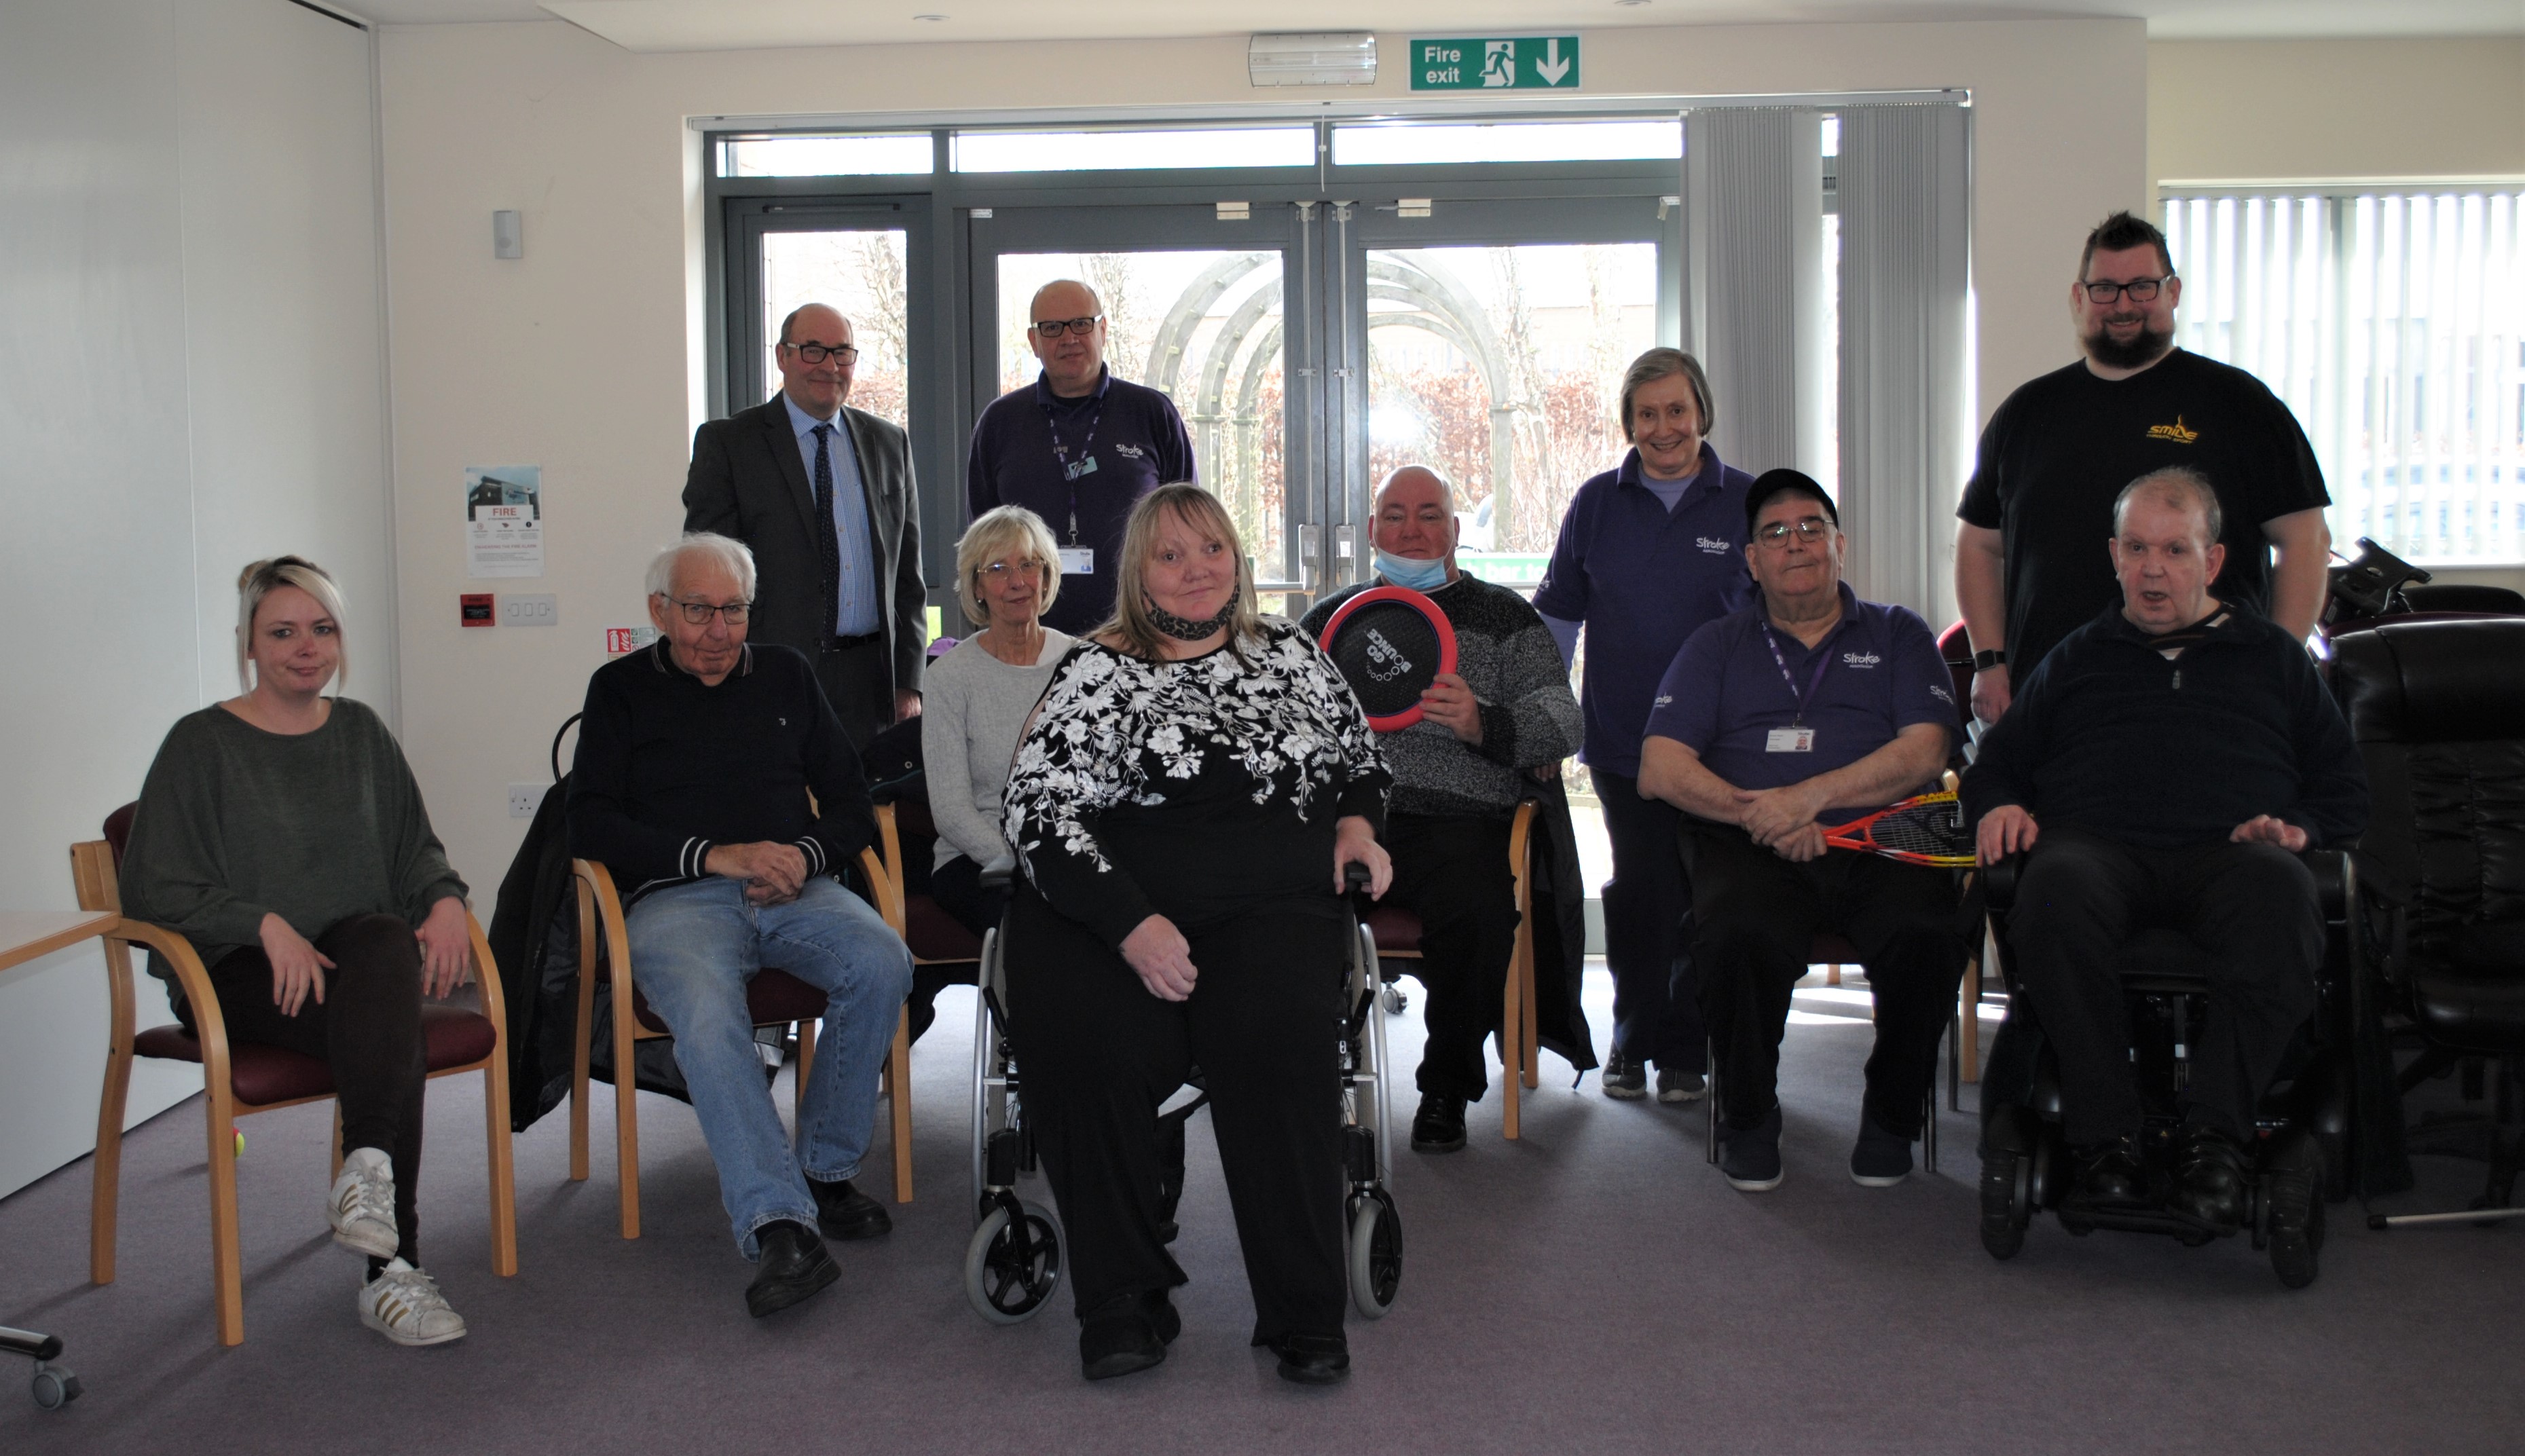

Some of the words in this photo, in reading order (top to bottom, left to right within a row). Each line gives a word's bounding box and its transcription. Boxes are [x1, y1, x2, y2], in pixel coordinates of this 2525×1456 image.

[1425, 46, 1460, 62] Fire
[1426, 67, 1460, 83] exit
[1116, 443, 1144, 455] Stroke
[492, 508, 517, 516] FIRE
[1696, 536, 1730, 551] Stroke
[1367, 628, 1412, 673] BOUNCE
[1367, 645, 1385, 663] GO
[1843, 651, 1880, 665] Stroke
